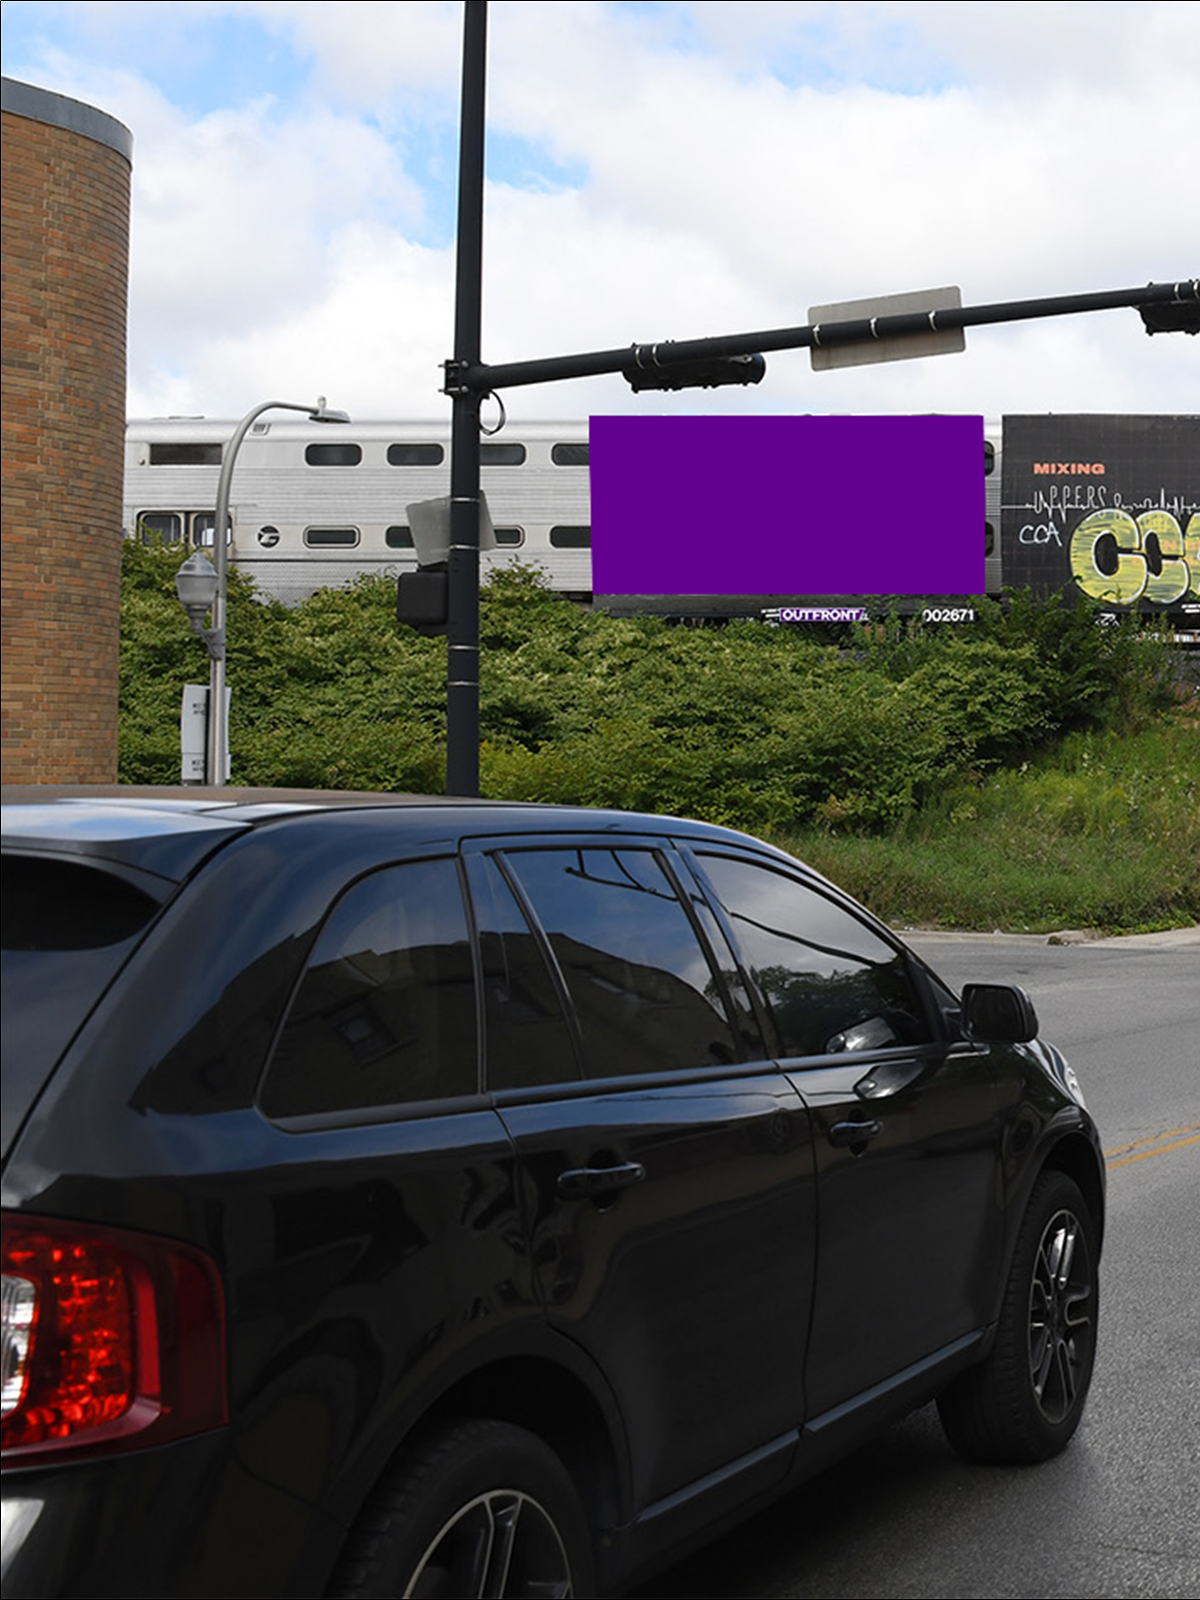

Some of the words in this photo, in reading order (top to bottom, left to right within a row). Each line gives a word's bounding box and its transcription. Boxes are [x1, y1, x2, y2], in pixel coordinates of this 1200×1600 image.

[1033, 463, 1105, 475] MIXING
[1019, 521, 1063, 547] CCA
[922, 608, 975, 623] 002671
